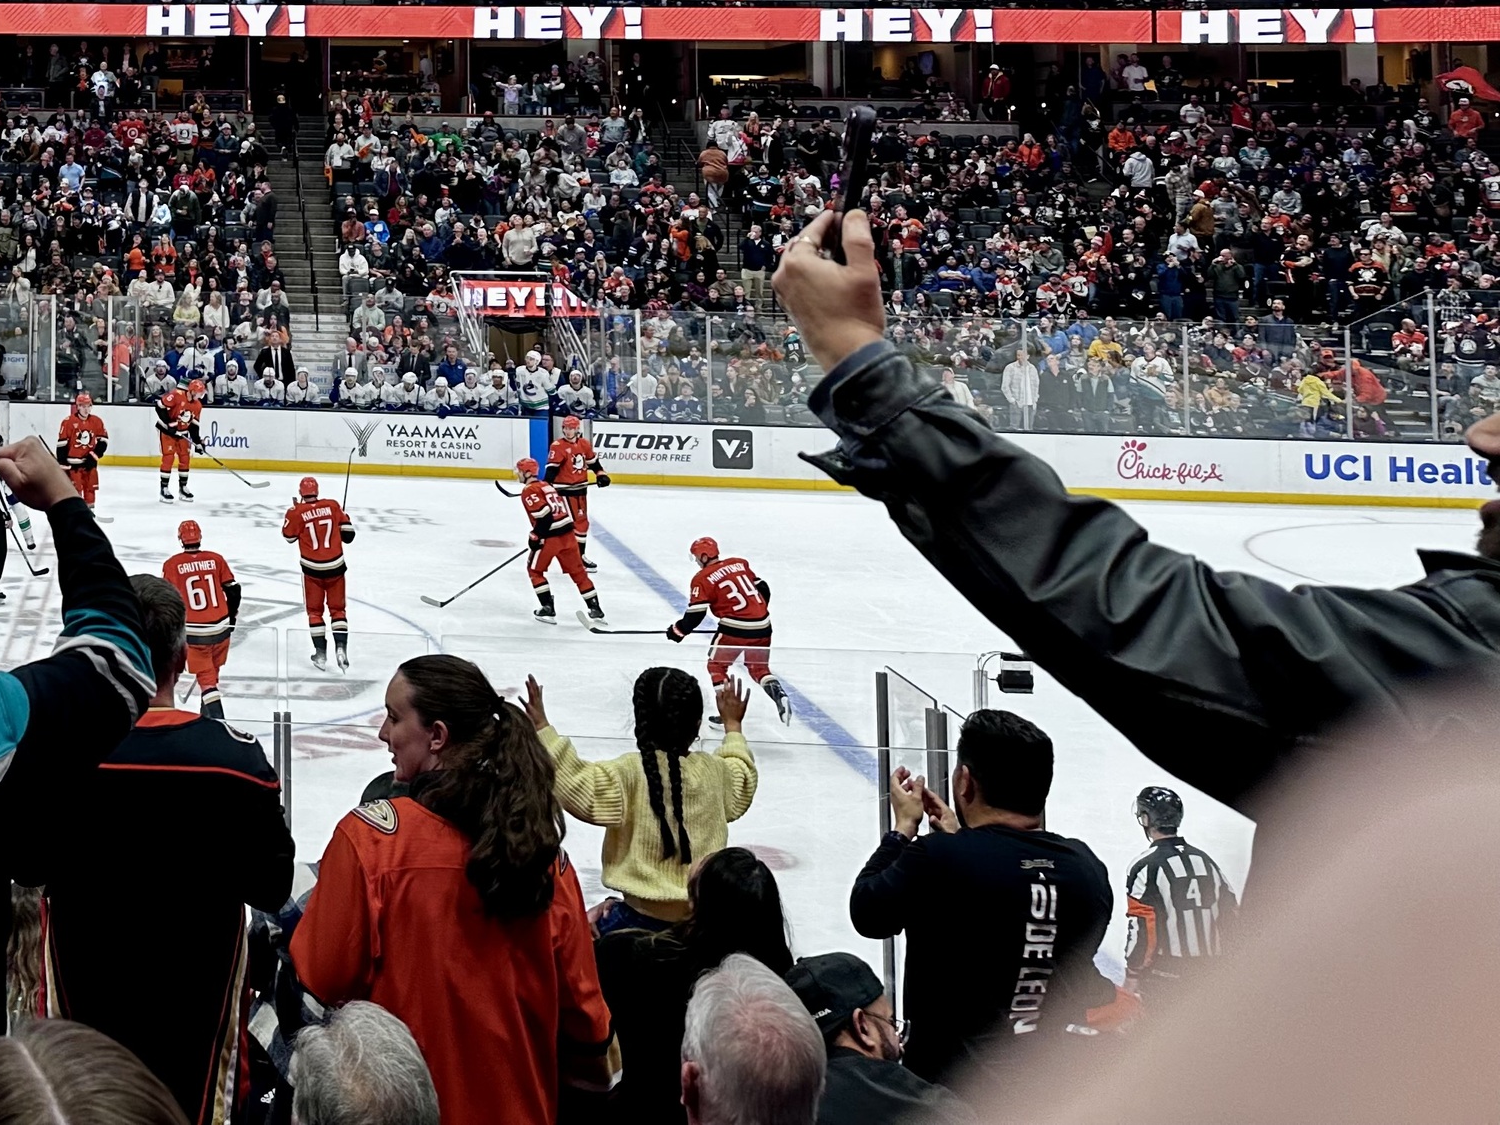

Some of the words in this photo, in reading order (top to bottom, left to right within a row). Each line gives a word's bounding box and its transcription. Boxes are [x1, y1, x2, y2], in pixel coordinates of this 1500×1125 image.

[145, 5, 306, 38] HEY!
[473, 6, 643, 40] HEY!
[819, 8, 994, 43] HEY!
[1180, 8, 1376, 44] HEY!
[463, 286, 546, 307] HEY!
[203, 421, 249, 448] aheim
[386, 440, 426, 449] RESORT
[431, 441, 437, 449] &
[440, 441, 481, 451] CASINO
[403, 450, 426, 459] SAN
[428, 451, 472, 460] MANUEL
[597, 452, 616, 461] EAM
[618, 452, 648, 462] DUCKS
[650, 453, 668, 462] FOR
[669, 453, 691, 463] FREE
[1117, 446, 1224, 482] Chick-fil-A
[1304, 453, 1370, 482] UCI
[1389, 455, 1492, 486] Healt
[301, 507, 331, 522] KILLORN
[525, 493, 540, 506] 65
[305, 518, 334, 550] 17
[177, 559, 217, 575] GAUTHIER
[185, 573, 218, 610] 61
[718, 574, 763, 612] 34
[1186, 878, 1202, 907] 4
[1022, 922, 1058, 959] DE
[1009, 967, 1053, 1035] LEON
